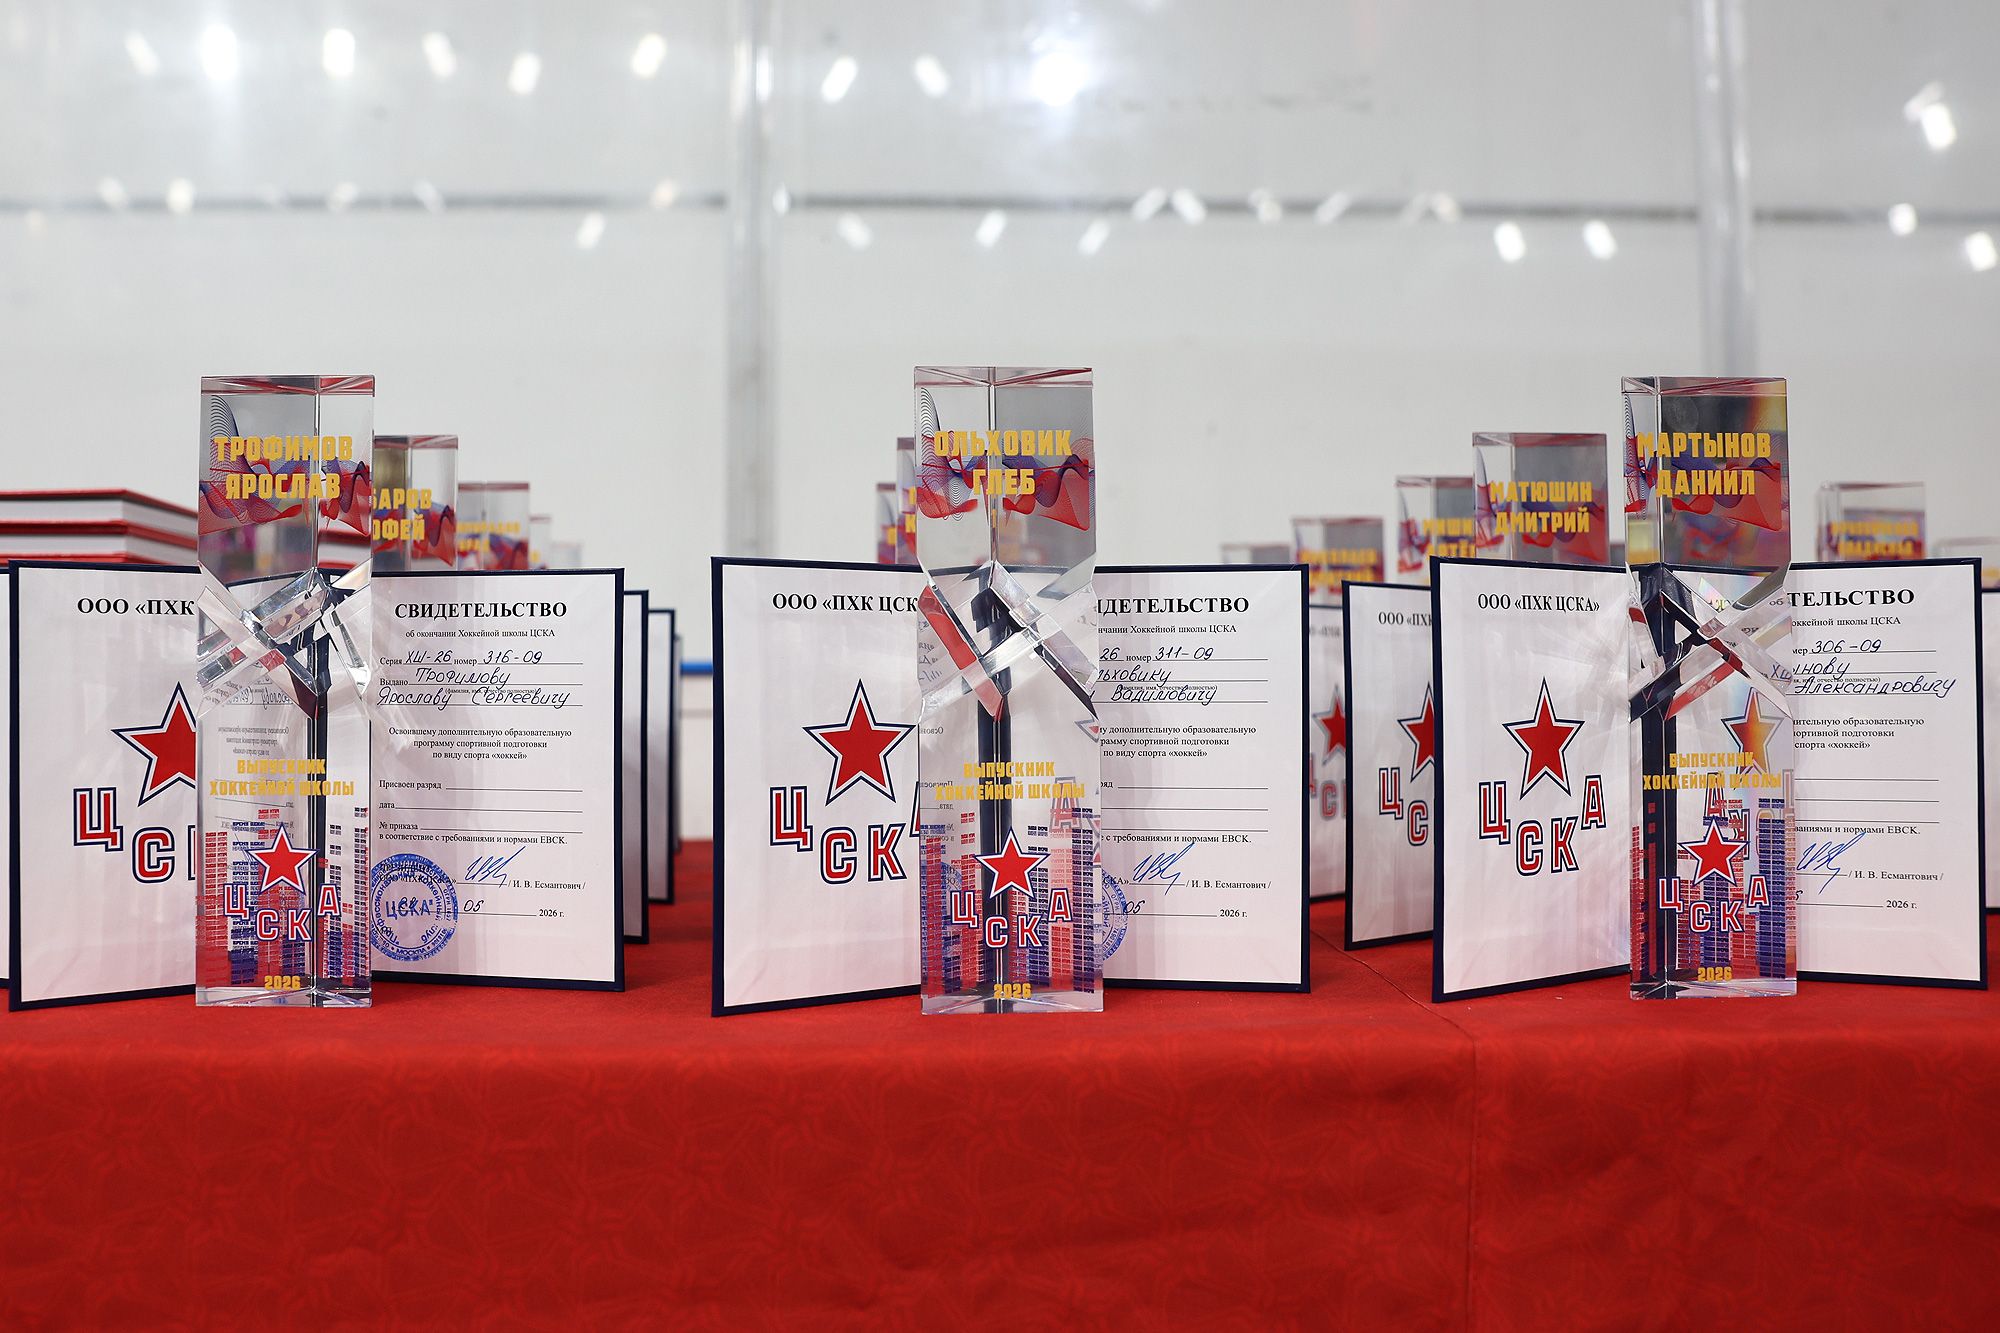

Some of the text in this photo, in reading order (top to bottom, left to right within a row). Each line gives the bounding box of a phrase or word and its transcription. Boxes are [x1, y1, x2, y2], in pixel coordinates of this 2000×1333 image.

[213, 436, 353, 461] ТРОФИМОВ
[934, 430, 1072, 456] ОЛЬХОВИК
[1637, 432, 1771, 458] МАРТЫНОВ
[225, 473, 341, 499] ЯРОСЛАВ
[973, 469, 1035, 495] ГЛЕБ
[1656, 470, 1755, 497] ДАНИИЛ
[1490, 481, 1592, 503] МАТЮШИН
[1495, 507, 1590, 533] ДМИТРИЙ
[77, 597, 195, 616] ООО «ПХК
[772, 593, 817, 610] ООО
[823, 594, 873, 612] «ПХК
[1477, 593, 1600, 613] ООО «ПХК ЦСКА»
[394, 602, 567, 620] СВИДЕТЕЛЬСТВО
[1378, 611, 1404, 625] ООО
[1837, 618, 1868, 626] школы
[1870, 616, 1901, 626] ЦСКА
[405, 630, 414, 638] об
[458, 629, 499, 638] Хоккейной
[530, 629, 556, 638] ЦСКА
[1130, 625, 1176, 634] Хоккейной
[1209, 625, 1237, 634] ЦСКА
[380, 657, 402, 666] Серия
[454, 658, 478, 666] номер
[1126, 654, 1152, 663] номер
[380, 679, 408, 687] Выдано
[1843, 718, 1924, 727] образовательную
[388, 727, 572, 738] Освоившему дополнительную образовательную
[1109, 726, 1257, 735] дополнительную образовательную
[1841, 731, 1894, 739] подготовки
[413, 739, 547, 749] программу спортивной подготовки
[1130, 738, 1178, 747] спортивной
[1181, 739, 1230, 747] подготовки
[1795, 741, 1870, 750] спорта «хоккей»
[444, 752, 461, 760] виду
[463, 752, 490, 761] спорта
[491, 752, 528, 760] «хоккей»
[1116, 750, 1135, 758] виду
[1138, 750, 1166, 758] спорта
[1168, 749, 1207, 757] «хоккей»
[1669, 751, 1754, 768] ВЫПУСКНИК
[237, 759, 326, 775] ВЫПУСКНИК
[963, 762, 1055, 778] ВЫПУСКНИК
[379, 780, 443, 790] Присвоен разряд
[1643, 771, 1782, 790] ХОККЕЙНОЙ ШКОЛЫ
[210, 777, 354, 796] ХОККЕЙНОЙ ШКОЛЫ
[935, 780, 1024, 800] ХОККЕЙНОЙ
[1027, 783, 1085, 799] ШКОЛЫ
[379, 802, 395, 810] дата
[379, 821, 418, 831] № приказа
[1478, 774, 1606, 876] ЦСКА
[1844, 826, 1884, 834] нормами
[1888, 825, 1920, 835] ЕВСК.
[386, 834, 433, 842] соответствие
[441, 834, 496, 844] требованиями
[504, 836, 538, 844] нормами
[540, 835, 568, 845] ЕВСК.
[1113, 835, 1172, 843] требованиями
[1182, 835, 1219, 843] нормами
[1221, 834, 1252, 843] ЕВСК.
[1854, 871, 1938, 881] И. В. Есмантович
[513, 880, 581, 891] И. В. Есмантович
[1191, 880, 1201, 888] И.
[1203, 880, 1213, 888] В.
[1215, 880, 1266, 890] Есмантович
[1658, 875, 1770, 933] ЦСКА
[1887, 900, 1909, 909] 2026
[223, 883, 342, 941] ЦСКА
[539, 909, 558, 918] 2026
[1220, 909, 1240, 918] 2026
[950, 888, 1072, 948] ЦСКА
[1697, 967, 1732, 982] 2026
[264, 975, 301, 990] 2026
[994, 983, 1032, 999] 2026
